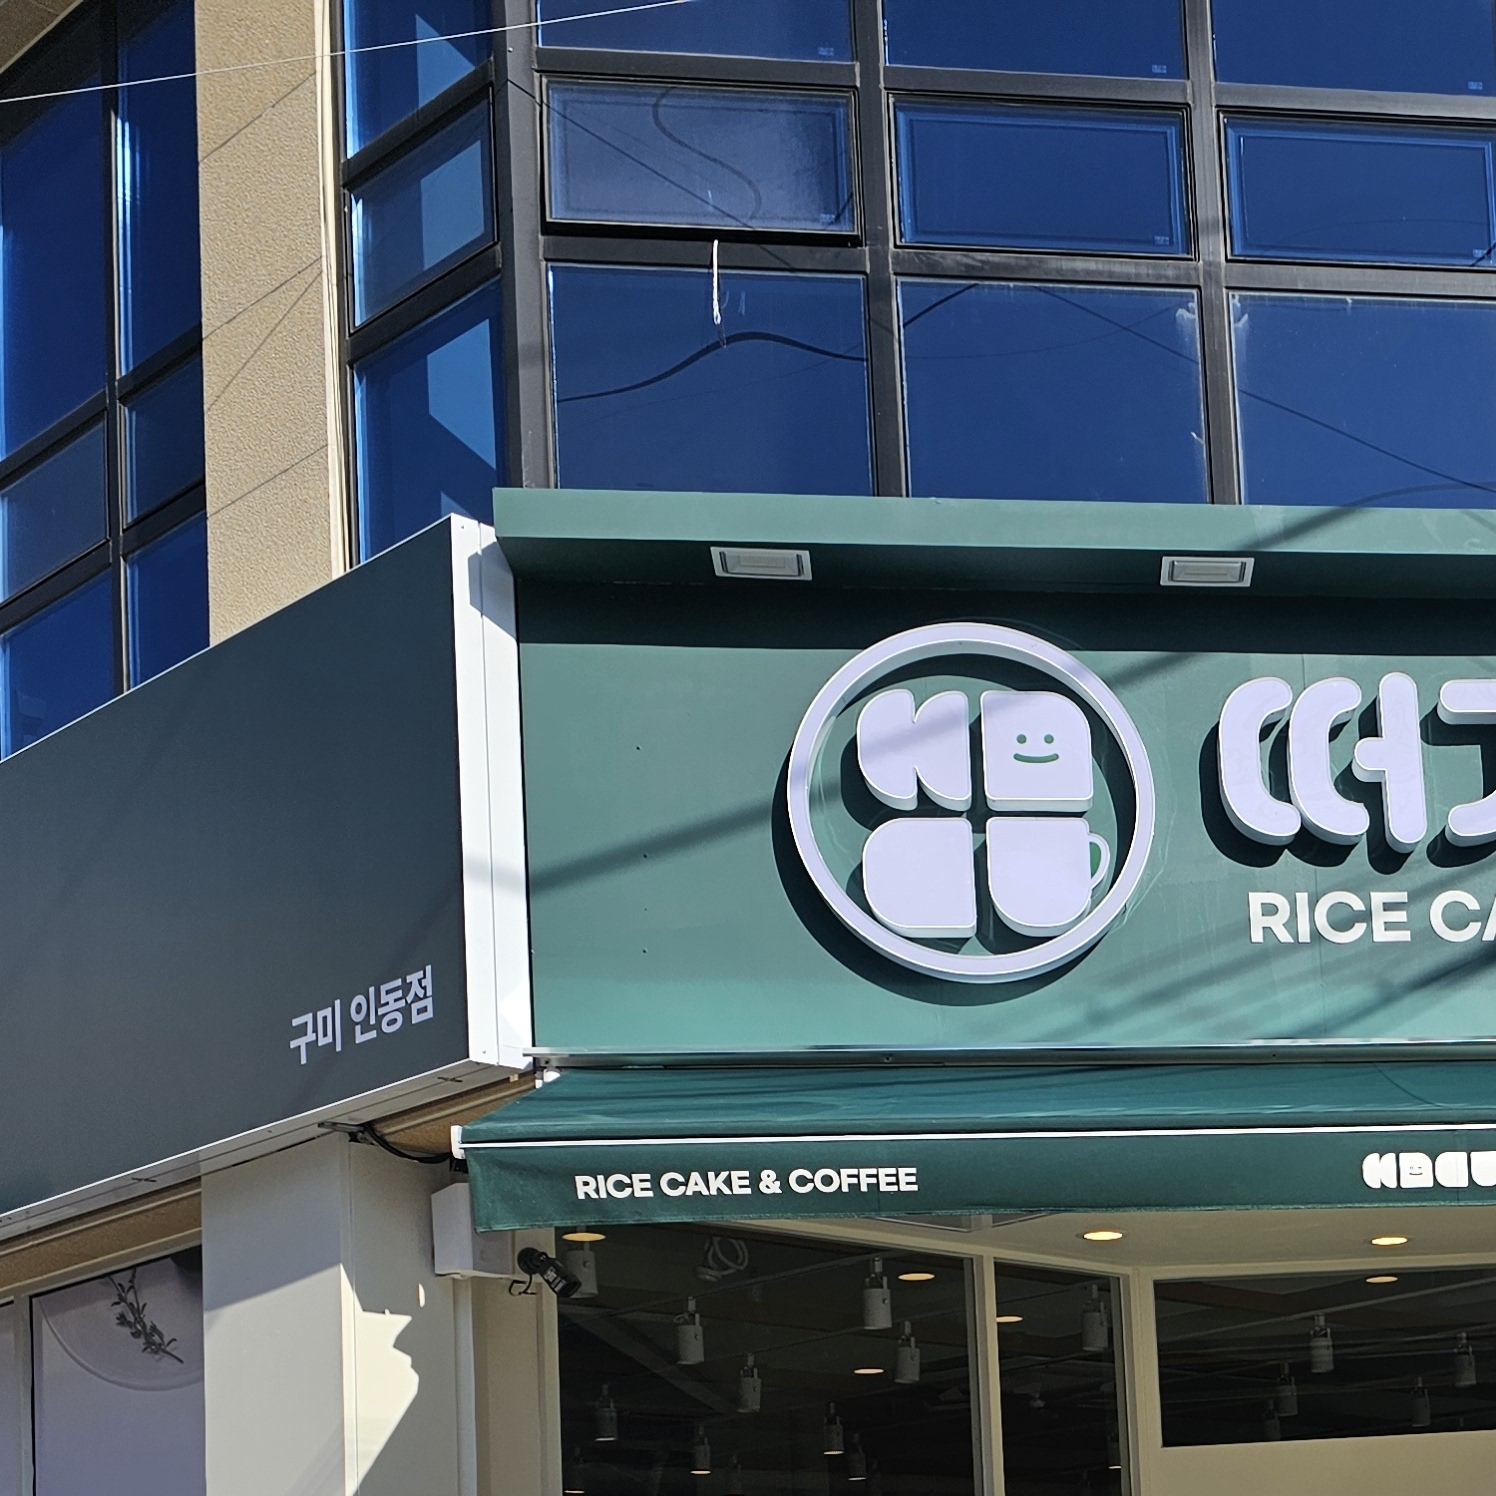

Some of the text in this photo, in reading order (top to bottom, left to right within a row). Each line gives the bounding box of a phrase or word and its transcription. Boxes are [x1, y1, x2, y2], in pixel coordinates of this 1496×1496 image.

[1250, 891, 1412, 945] RICE
[289, 965, 434, 1065] 구미 인동점
[574, 1166, 918, 1200] RICE CAKE & COFFEE
